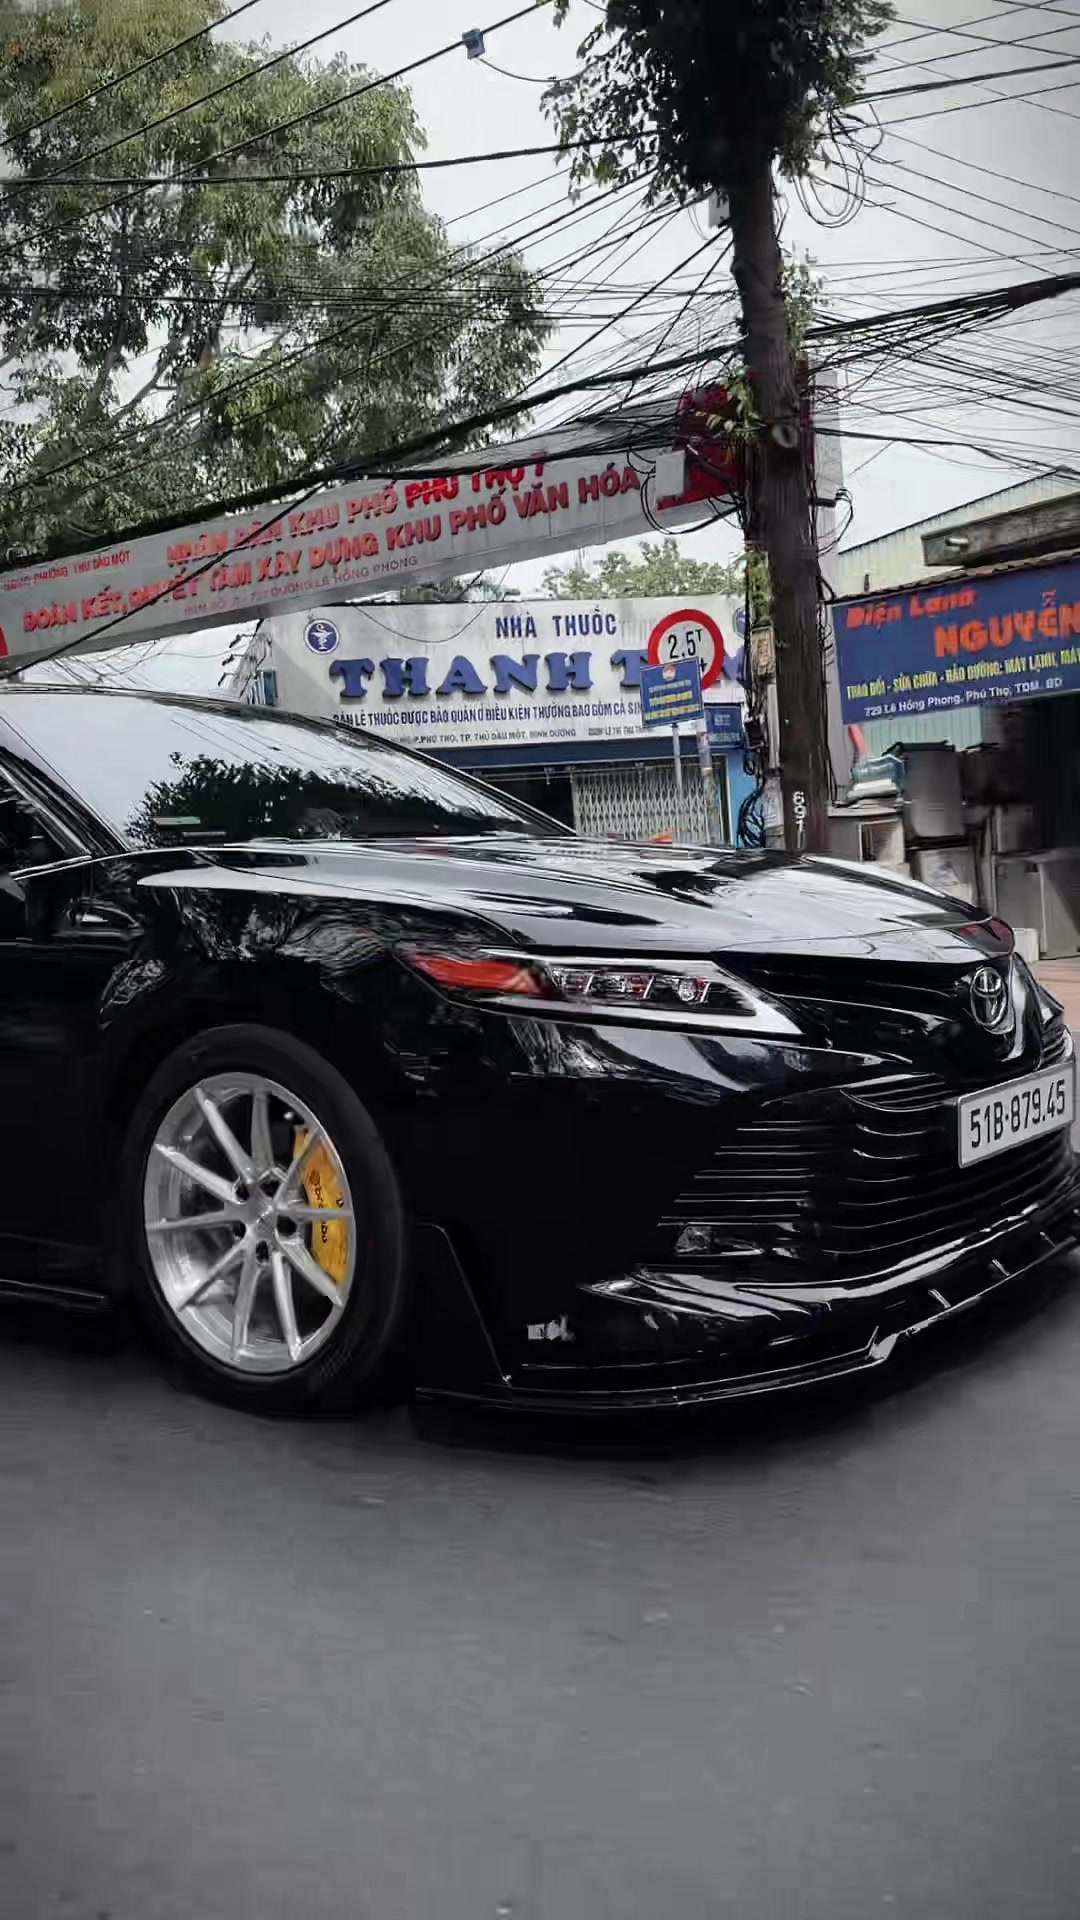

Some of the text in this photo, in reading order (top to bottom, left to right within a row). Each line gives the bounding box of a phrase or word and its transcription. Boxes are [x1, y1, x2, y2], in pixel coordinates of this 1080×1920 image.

[287, 503, 341, 539] KHU
[345, 479, 399, 524] PHỐ
[23, 601, 78, 633] ĐOÀN
[209, 562, 252, 592] TÂM
[256, 551, 303, 582] XÂY
[309, 532, 380, 573] DỰNG
[386, 514, 442, 551] KHU
[449, 487, 508, 535] PHỐ
[513, 481, 570, 519] VĂN
[577, 461, 642, 505] HÓA
[495, 605, 618, 639] NHÀ THUỐC
[329, 654, 593, 697] THANH
[892, 672, 911, 693] SỬA
[913, 670, 938, 689] CHỮA
[945, 663, 967, 684] BẢO
[966, 686, 987, 701] Phú
[368, 707, 400, 726] THUỐC
[400, 709, 429, 727] ĐƯỢC
[430, 705, 449, 724] BẢO
[450, 704, 477, 723] QUẢN
[485, 702, 507, 721] ĐIỀU
[532, 700, 571, 719] THƯỜNG
[572, 701, 591, 717] BAO
[591, 699, 612, 717] GỒM
[613, 699, 627, 716] CẢ
